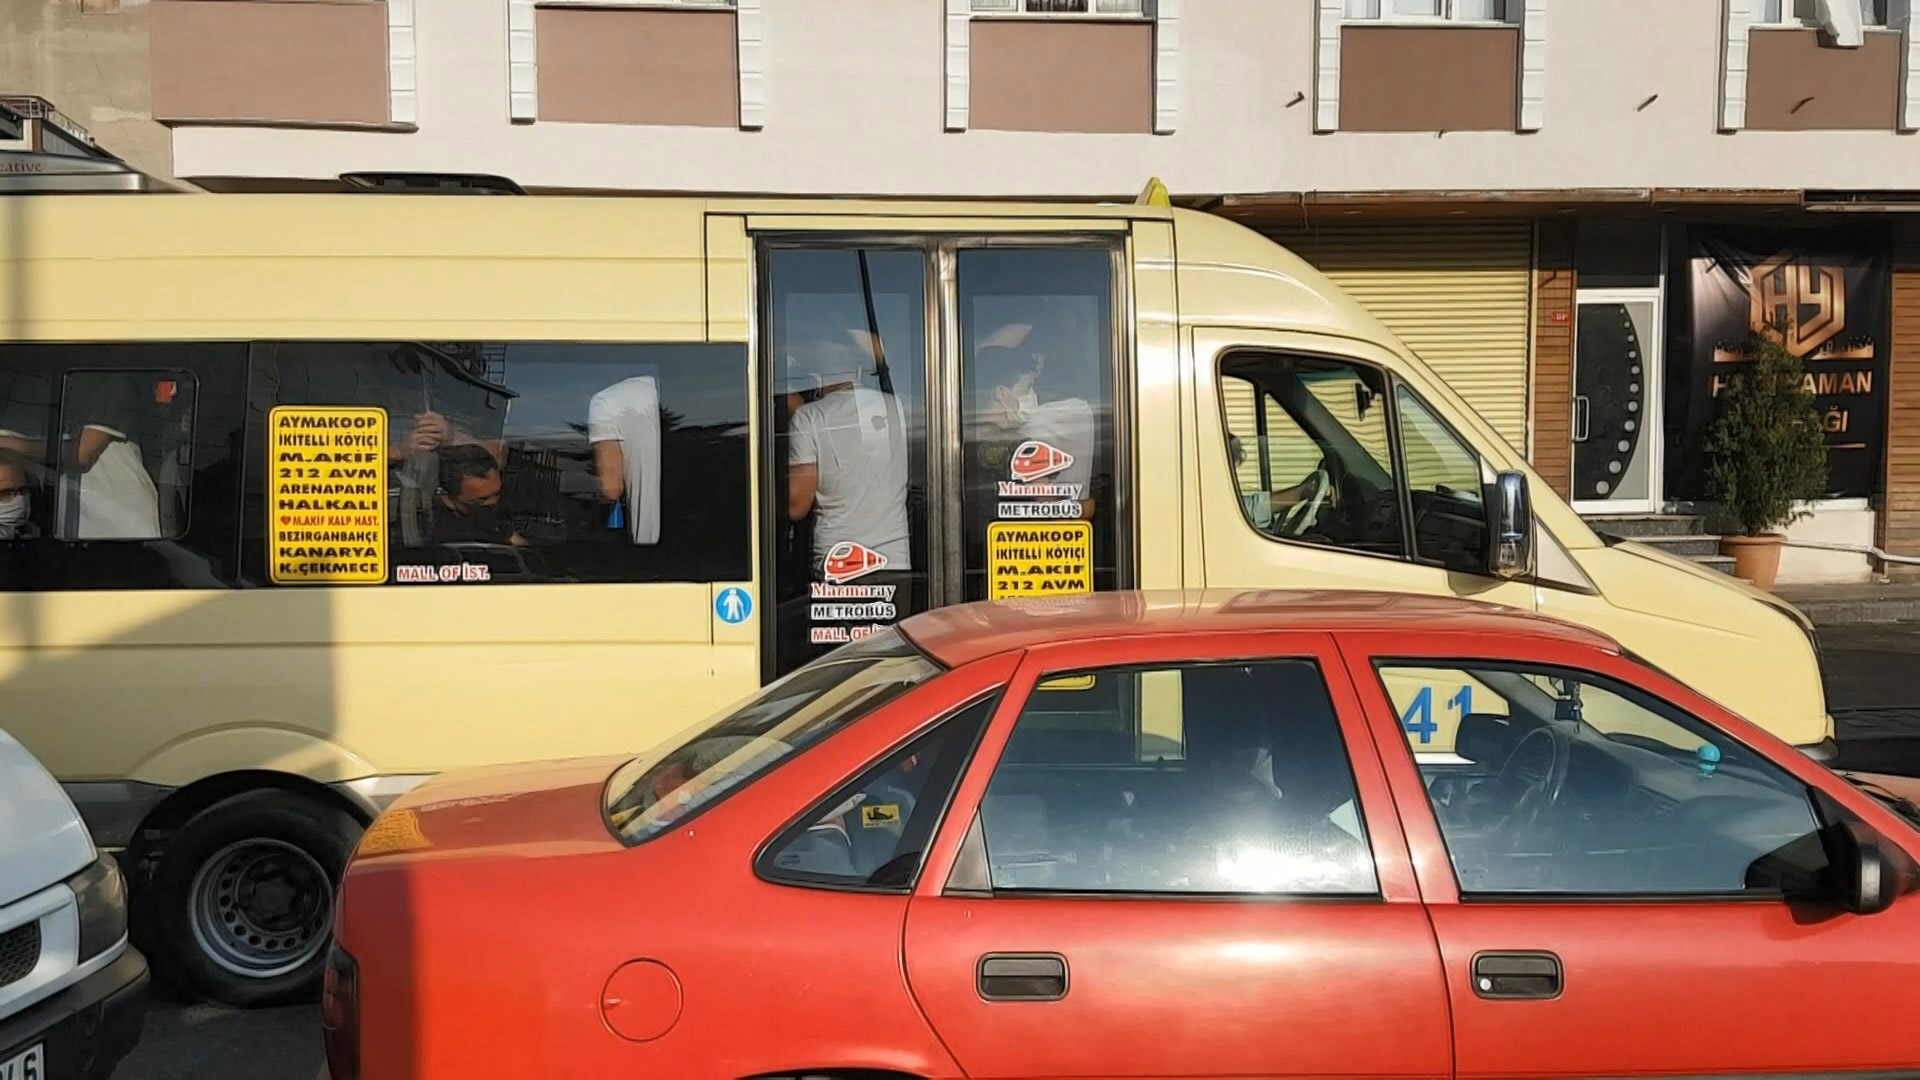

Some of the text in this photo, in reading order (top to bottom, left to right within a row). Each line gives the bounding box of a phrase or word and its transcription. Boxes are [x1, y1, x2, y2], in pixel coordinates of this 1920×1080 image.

[280, 416, 377, 428] AYMAKOOP
[279, 430, 378, 450] İKİTELLİ KÖYİÇİ
[280, 449, 378, 462] M.AKİF
[280, 468, 377, 478] 212 AVM
[280, 484, 377, 494] ARENAPARK
[998, 482, 1081, 500] Marmaray
[279, 499, 378, 510] HALKALI
[328, 515, 351, 526] KALP
[279, 530, 378, 544] BEZİRGANBAHÇE
[996, 531, 1084, 542] AYMAKOOP
[280, 547, 377, 558] KANARYA
[280, 563, 379, 576] K.ÇEKMECE
[398, 566, 437, 580] MALL
[441, 566, 460, 580] OF
[997, 561, 1085, 576] M.AKİF
[812, 582, 895, 601] Marmaray
[997, 580, 1085, 590] 212 AVM
[813, 628, 849, 642] MALL
